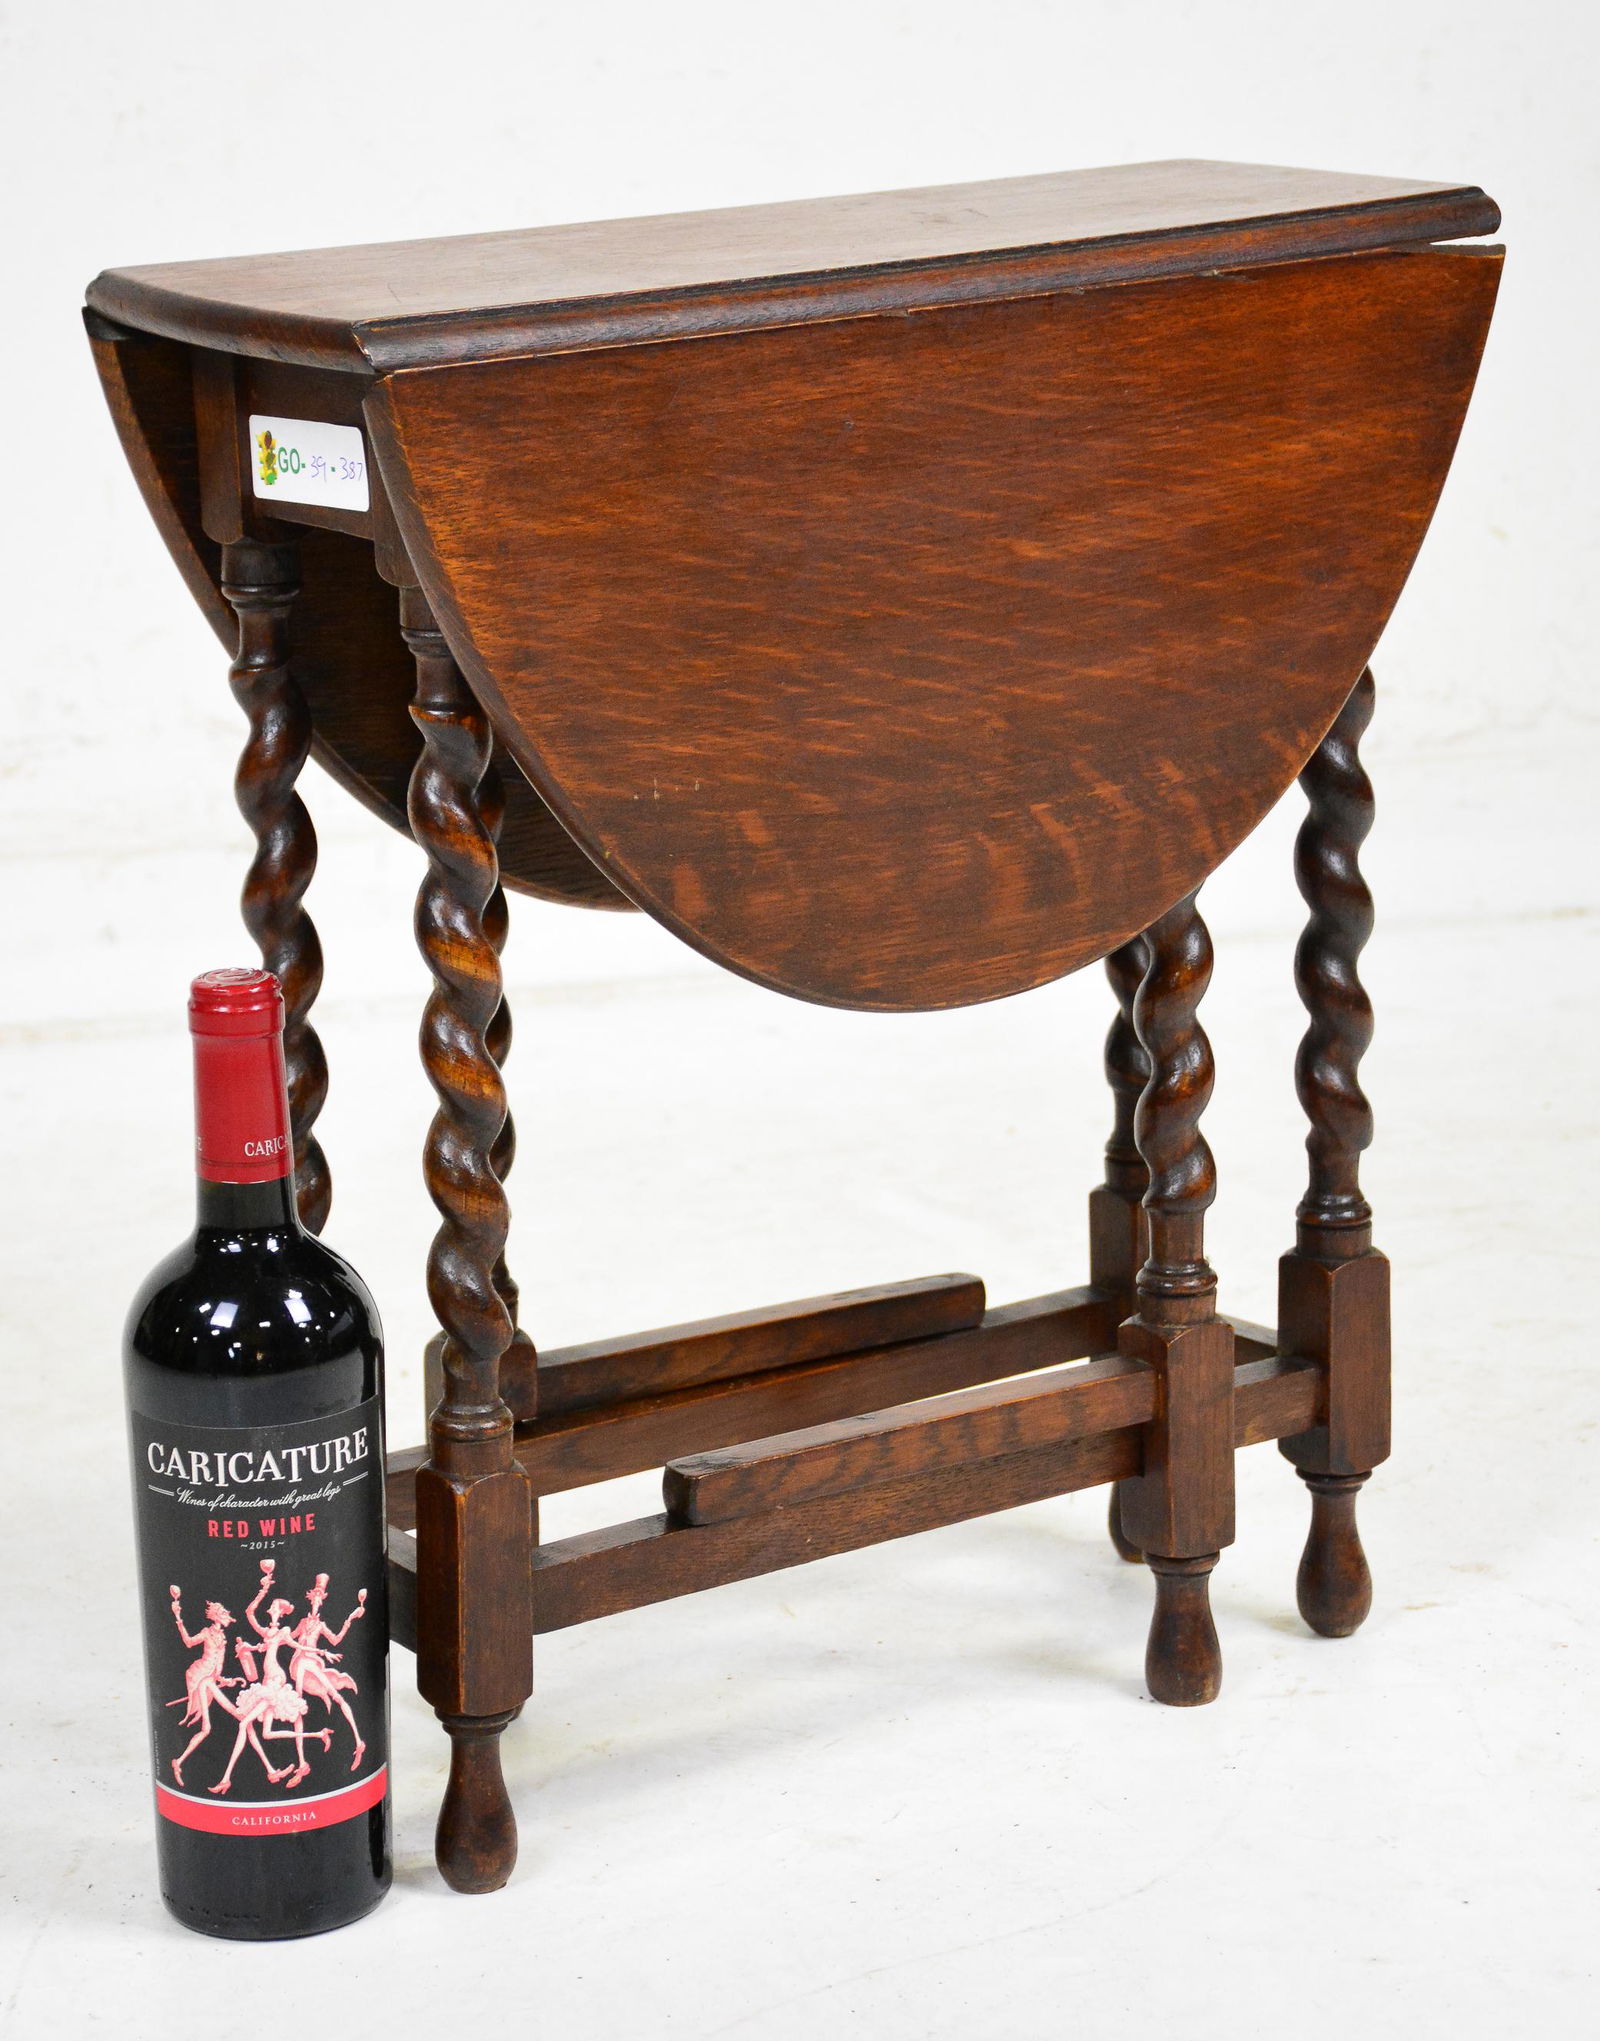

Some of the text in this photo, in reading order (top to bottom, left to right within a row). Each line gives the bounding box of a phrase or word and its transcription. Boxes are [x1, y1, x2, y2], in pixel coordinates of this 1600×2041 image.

[147, 1426, 369, 1487] CARICATURE
[176, 1481, 342, 1512] Wines of character with great legs
[207, 1513, 316, 1538] RED WINE
[232, 1811, 317, 1826] CALIFORNIA
